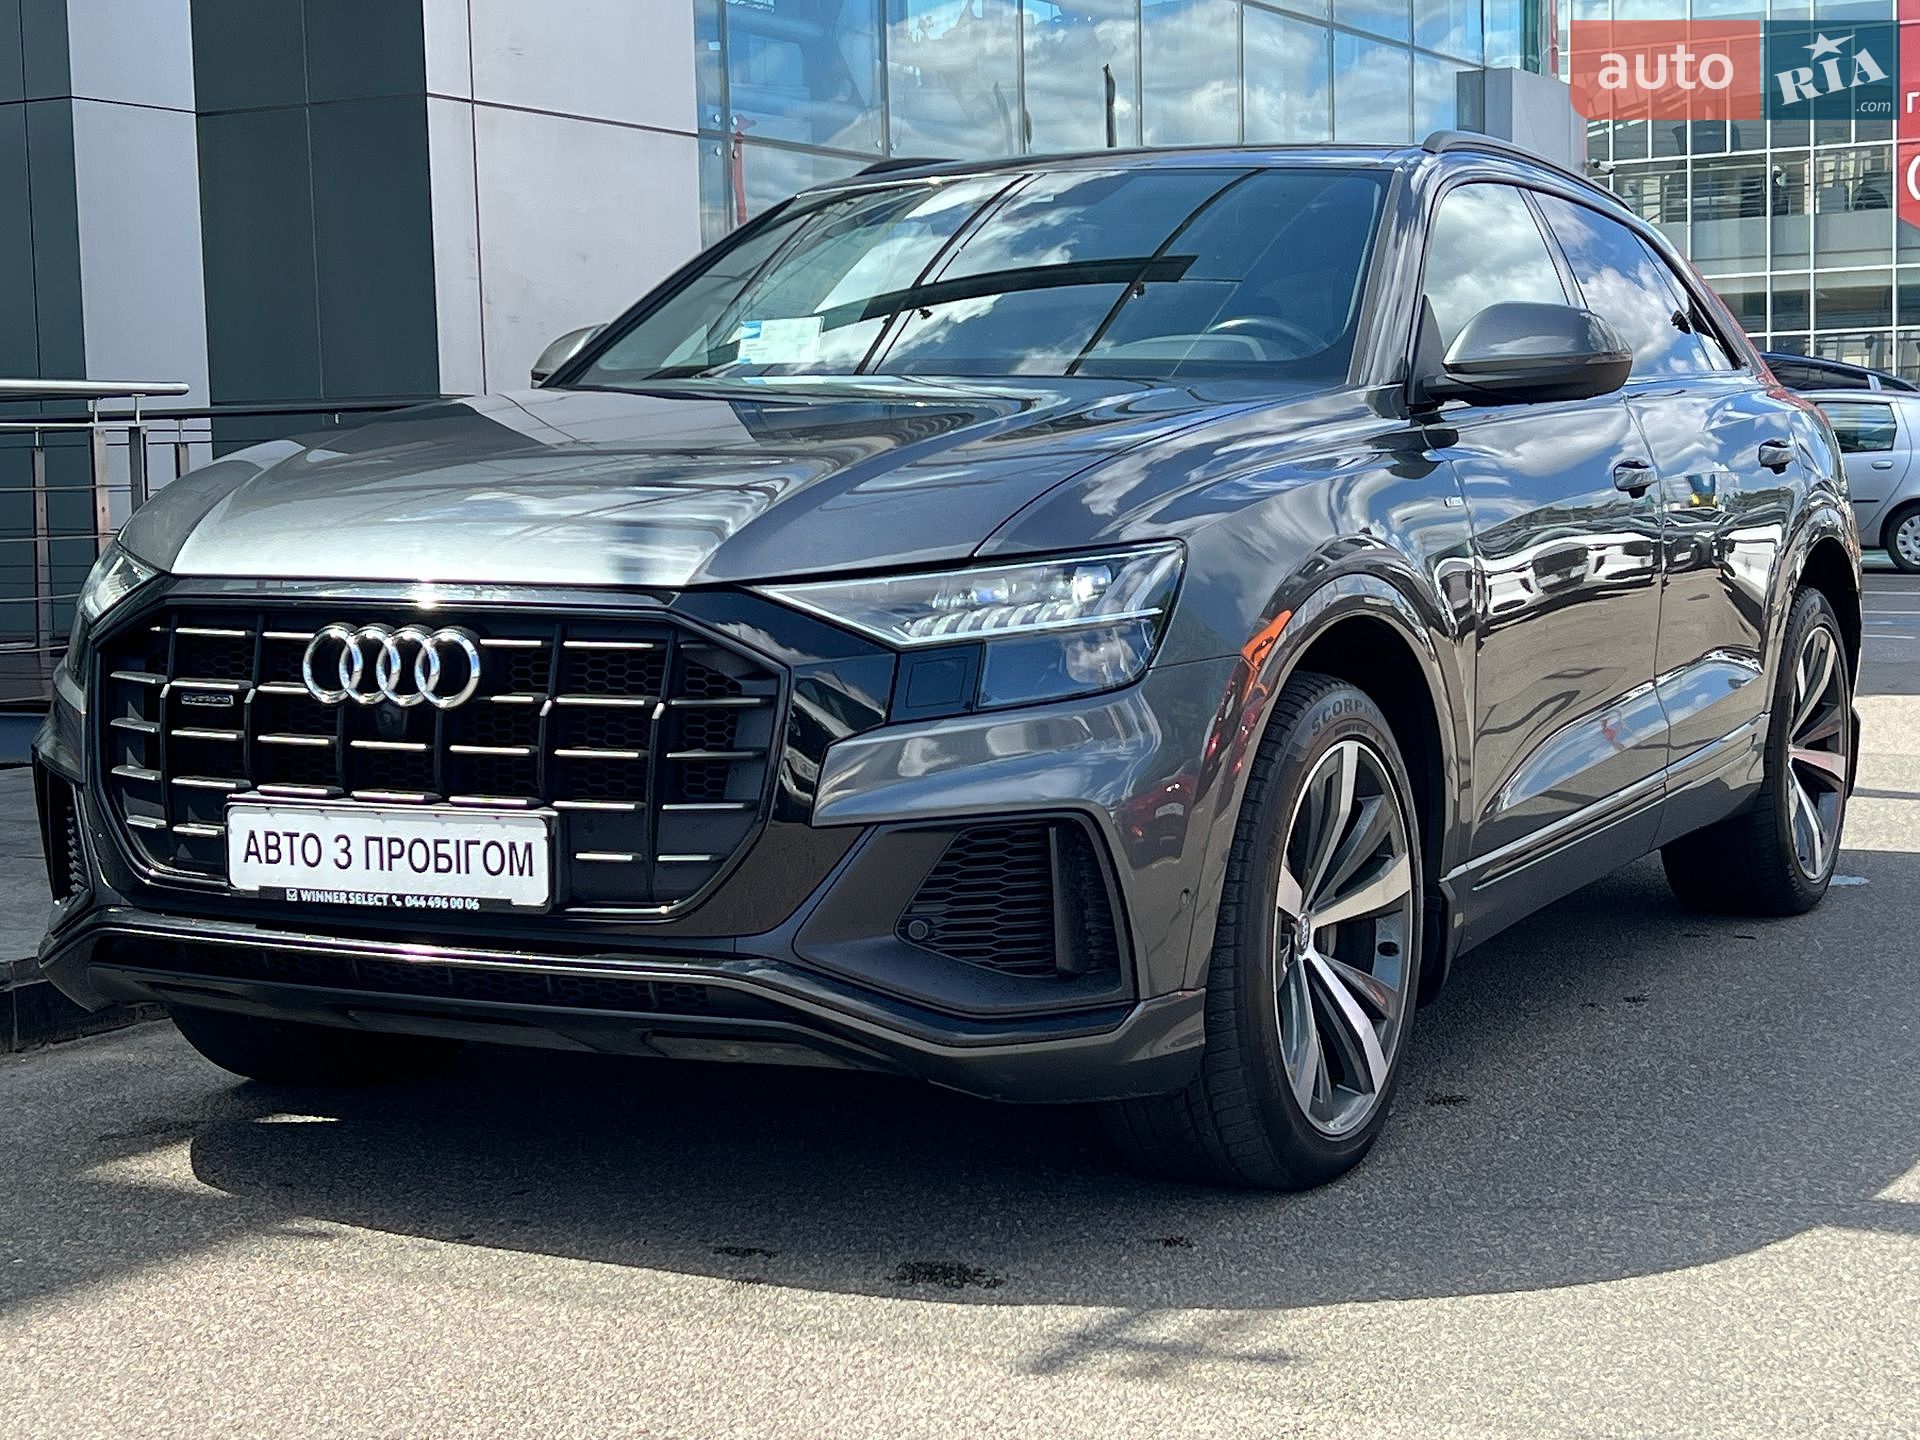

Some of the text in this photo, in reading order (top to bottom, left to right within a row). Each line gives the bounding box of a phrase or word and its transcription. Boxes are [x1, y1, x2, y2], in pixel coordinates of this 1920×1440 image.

[1311, 698, 1380, 736] SCORPI
[243, 829, 322, 868] АВТО
[364, 835, 534, 877] ПРОБІГОМ
[301, 889, 347, 904] WINNER
[348, 892, 389, 906] SELECT
